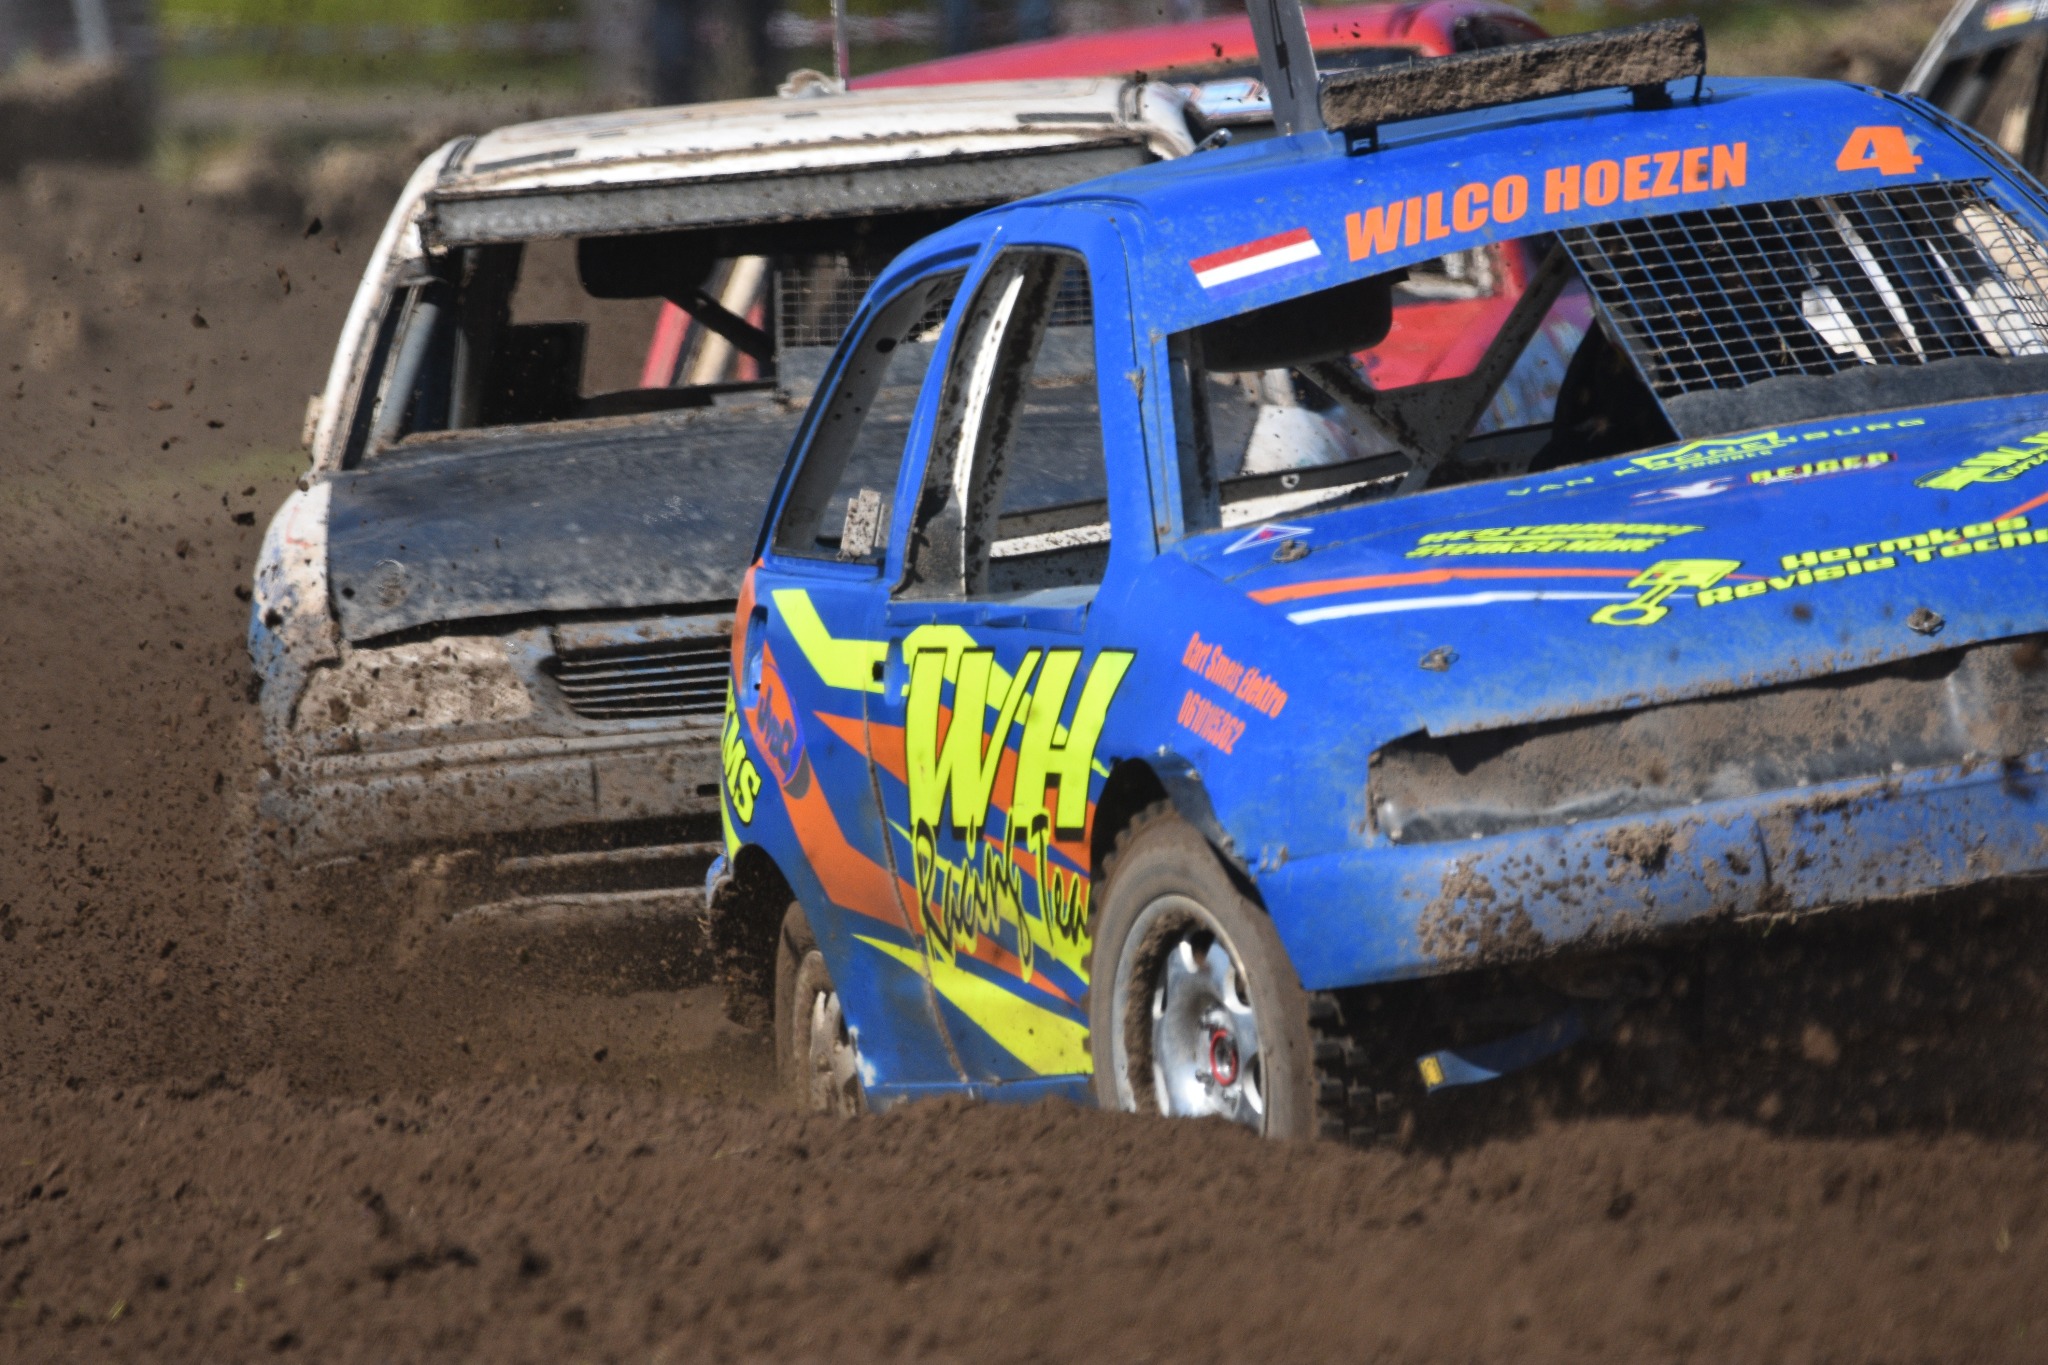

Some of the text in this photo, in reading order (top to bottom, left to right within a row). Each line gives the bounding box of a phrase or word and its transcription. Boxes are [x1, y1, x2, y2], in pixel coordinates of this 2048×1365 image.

[1836, 125, 1924, 178] 4
[1344, 141, 1748, 262] WILCO HOEZEN
[1506, 476, 1595, 496] VAN
[1696, 556, 1897, 608] Revisie
[904, 646, 1138, 842] WH
[914, 809, 1033, 977] Racing
